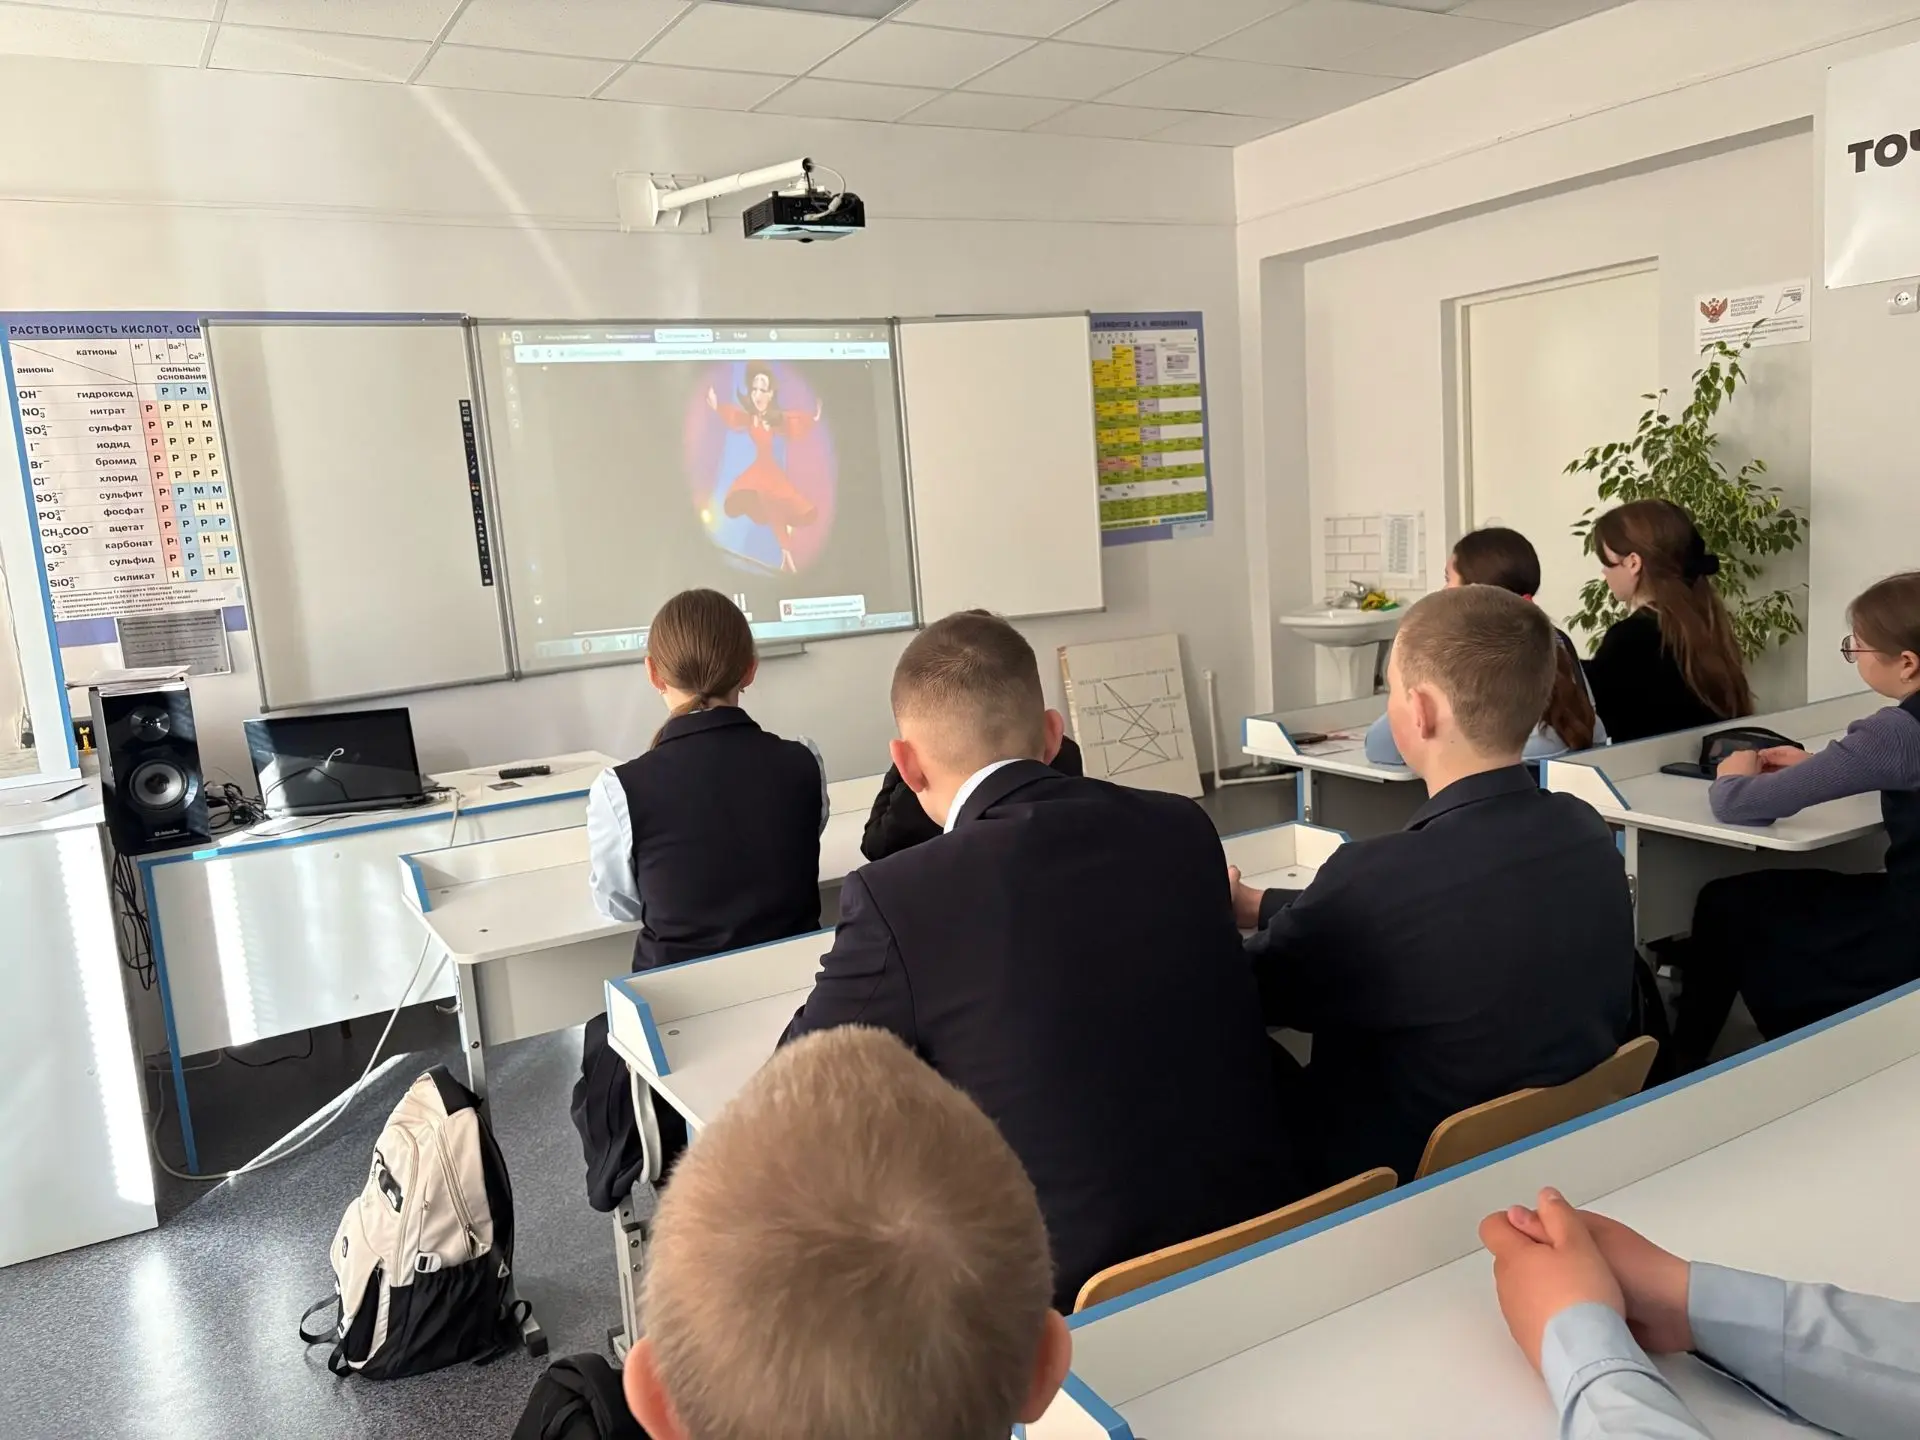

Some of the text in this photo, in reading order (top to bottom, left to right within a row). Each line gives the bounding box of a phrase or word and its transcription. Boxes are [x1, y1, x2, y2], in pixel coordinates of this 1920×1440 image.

[10, 325, 200, 334] РАСТВОРИМОСТЬ КИСЛОТ, ОСН
[77, 389, 133, 399] гидроксид
[89, 423, 132, 432] сульфат
[97, 441, 130, 449] иодид
[96, 457, 136, 466] бромид
[100, 474, 138, 483] хлорид
[100, 490, 143, 499] сульфит
[104, 507, 144, 517] фосфат
[109, 524, 144, 533] ацетат
[105, 540, 153, 549] карбонат
[110, 556, 155, 565] сульфид
[114, 572, 155, 581] силикат
